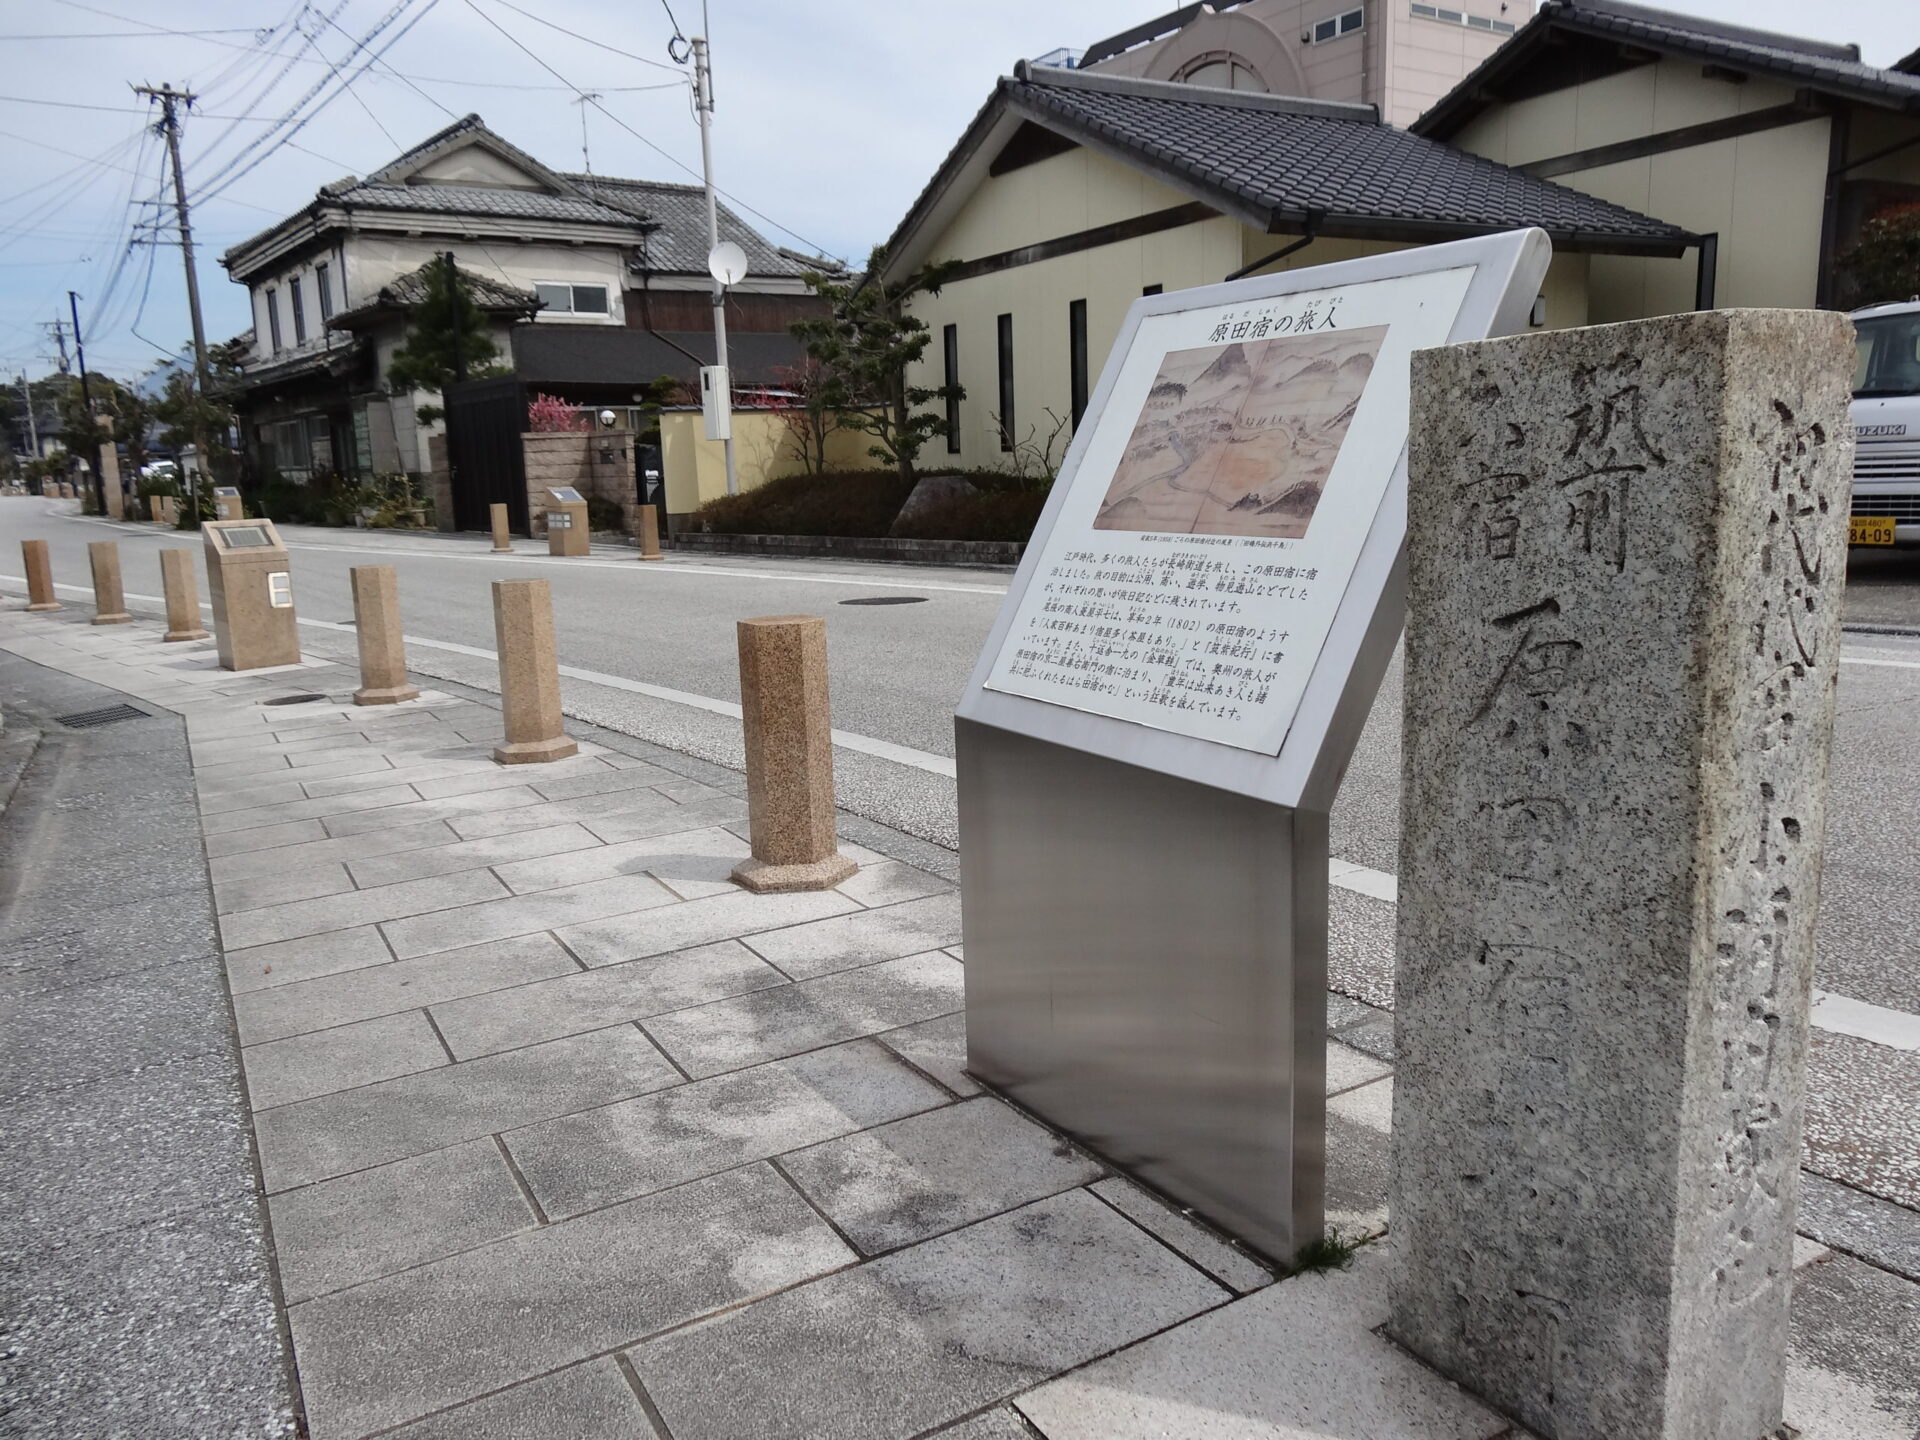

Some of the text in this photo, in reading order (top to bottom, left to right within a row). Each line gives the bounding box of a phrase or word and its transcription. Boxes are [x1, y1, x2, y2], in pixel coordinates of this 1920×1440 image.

[1208, 306, 1337, 342] 原田宿の旅人
[1855, 424, 1907, 436] UZUKI
[1850, 528, 1892, 543] 84-09
